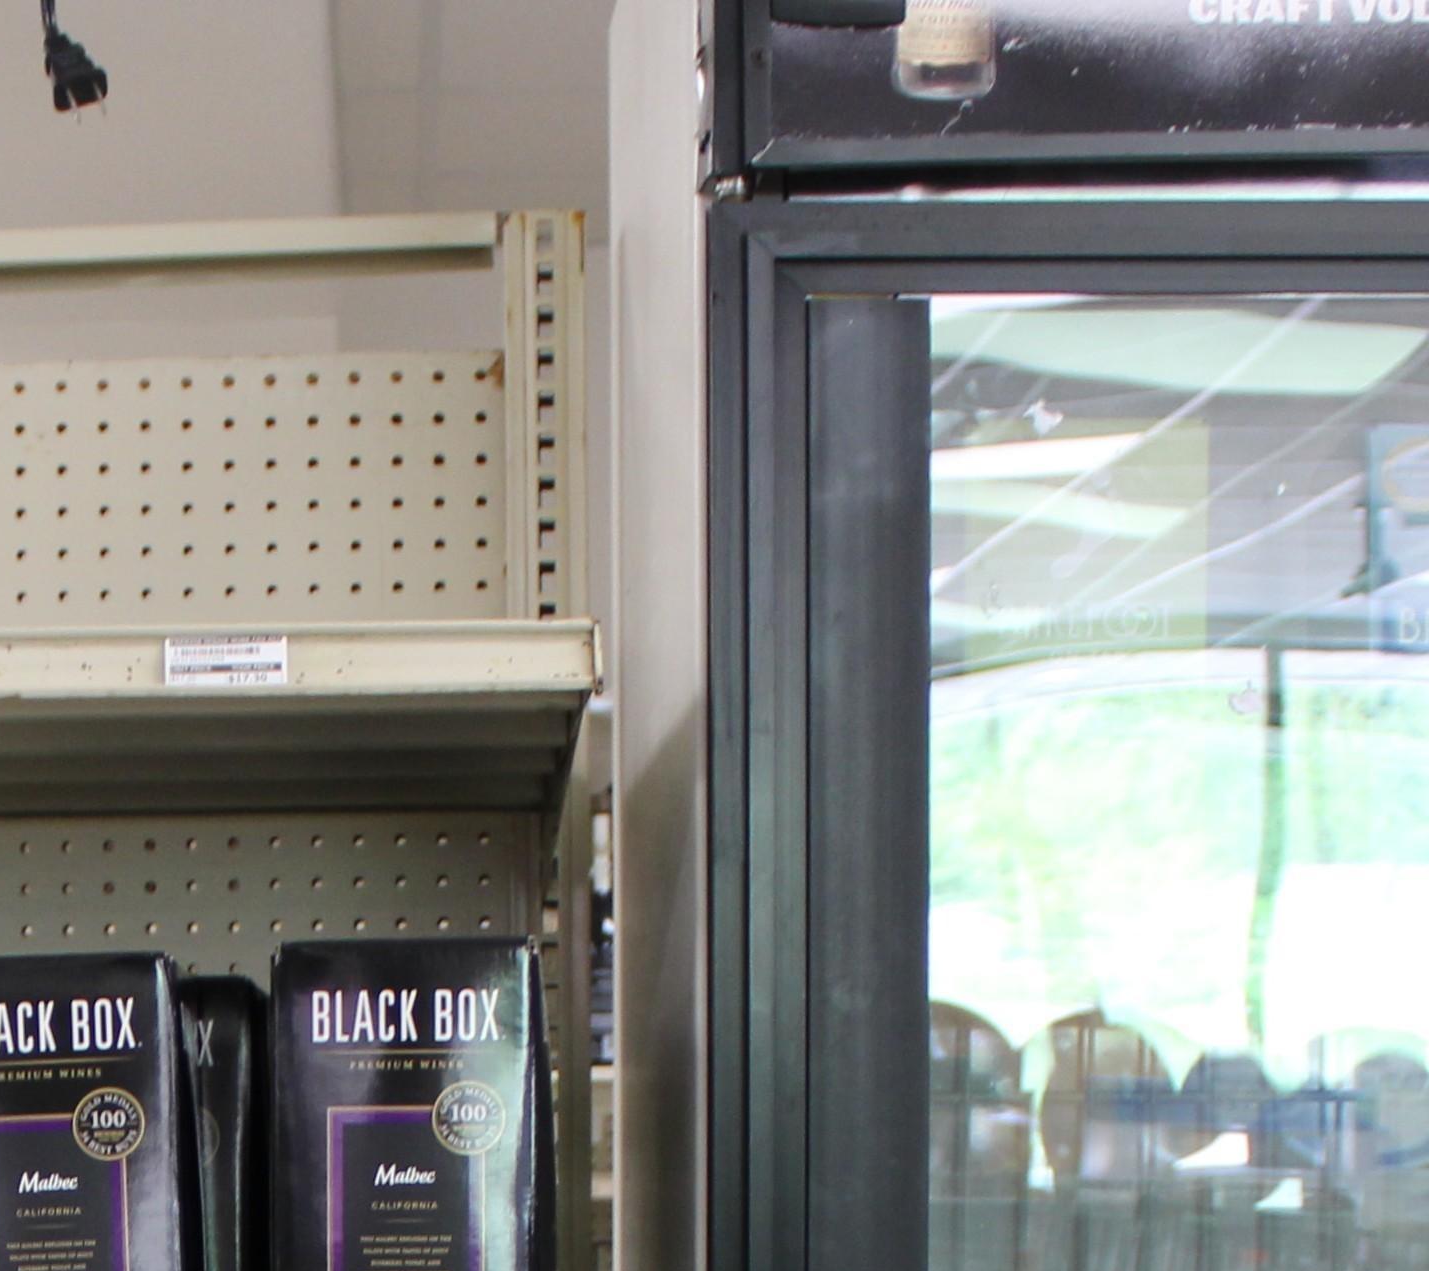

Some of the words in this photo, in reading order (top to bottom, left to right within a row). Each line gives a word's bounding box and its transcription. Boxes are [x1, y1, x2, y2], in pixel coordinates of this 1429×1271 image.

[71, 997, 142, 1051] BOX
[312, 988, 418, 1043] BLACK
[434, 987, 506, 1042] BOX
[59, 1067, 102, 1079] WINES
[350, 1060, 414, 1070] PREMIUM
[420, 1059, 464, 1069] WINES
[90, 1109, 127, 1128] 100
[450, 1103, 487, 1122] 100
[18, 1171, 78, 1193] Malbec
[374, 1164, 437, 1186] Malbec
[16, 1206, 82, 1217] CALIFORNIA
[371, 1201, 438, 1211] CALIFORNIA
